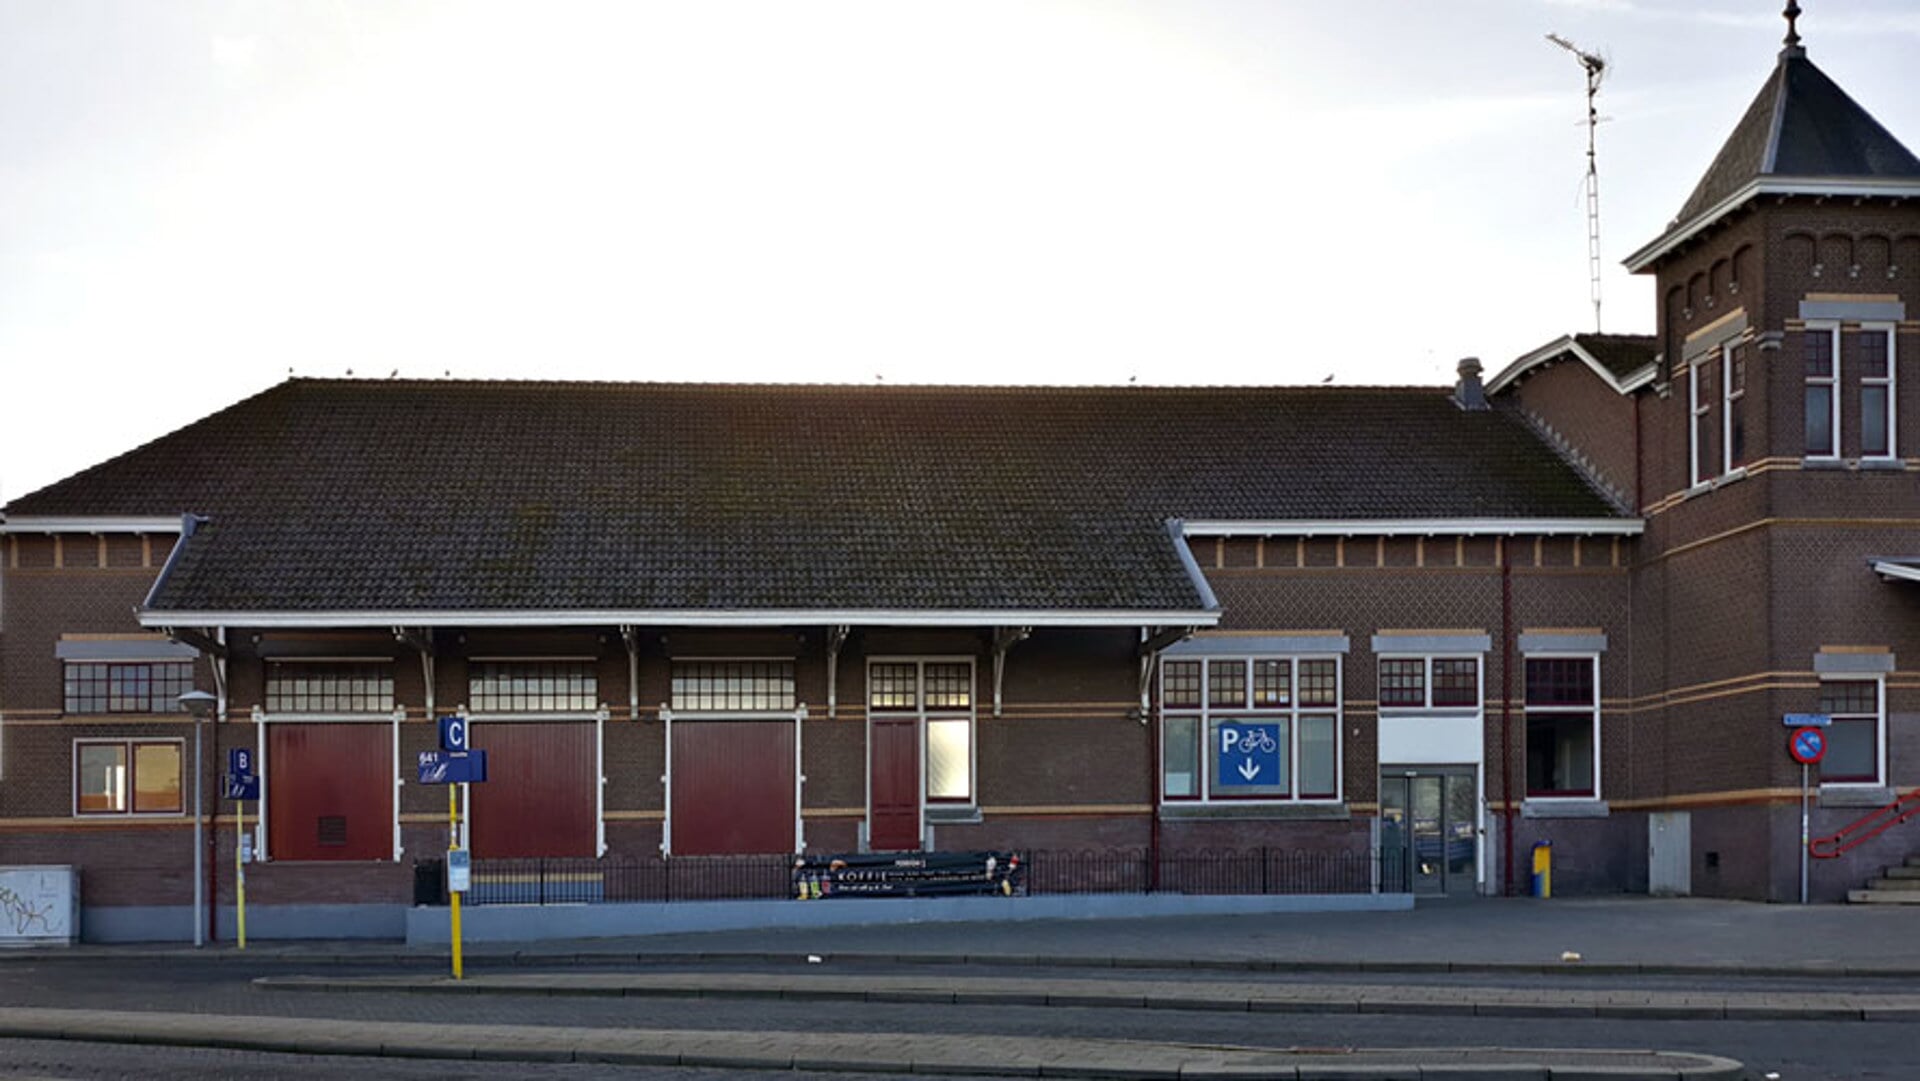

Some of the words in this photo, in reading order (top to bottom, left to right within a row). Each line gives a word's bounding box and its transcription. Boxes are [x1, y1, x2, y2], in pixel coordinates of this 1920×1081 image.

[449, 721, 462, 746] C
[1223, 728, 1239, 753] P
[239, 752, 248, 769] B
